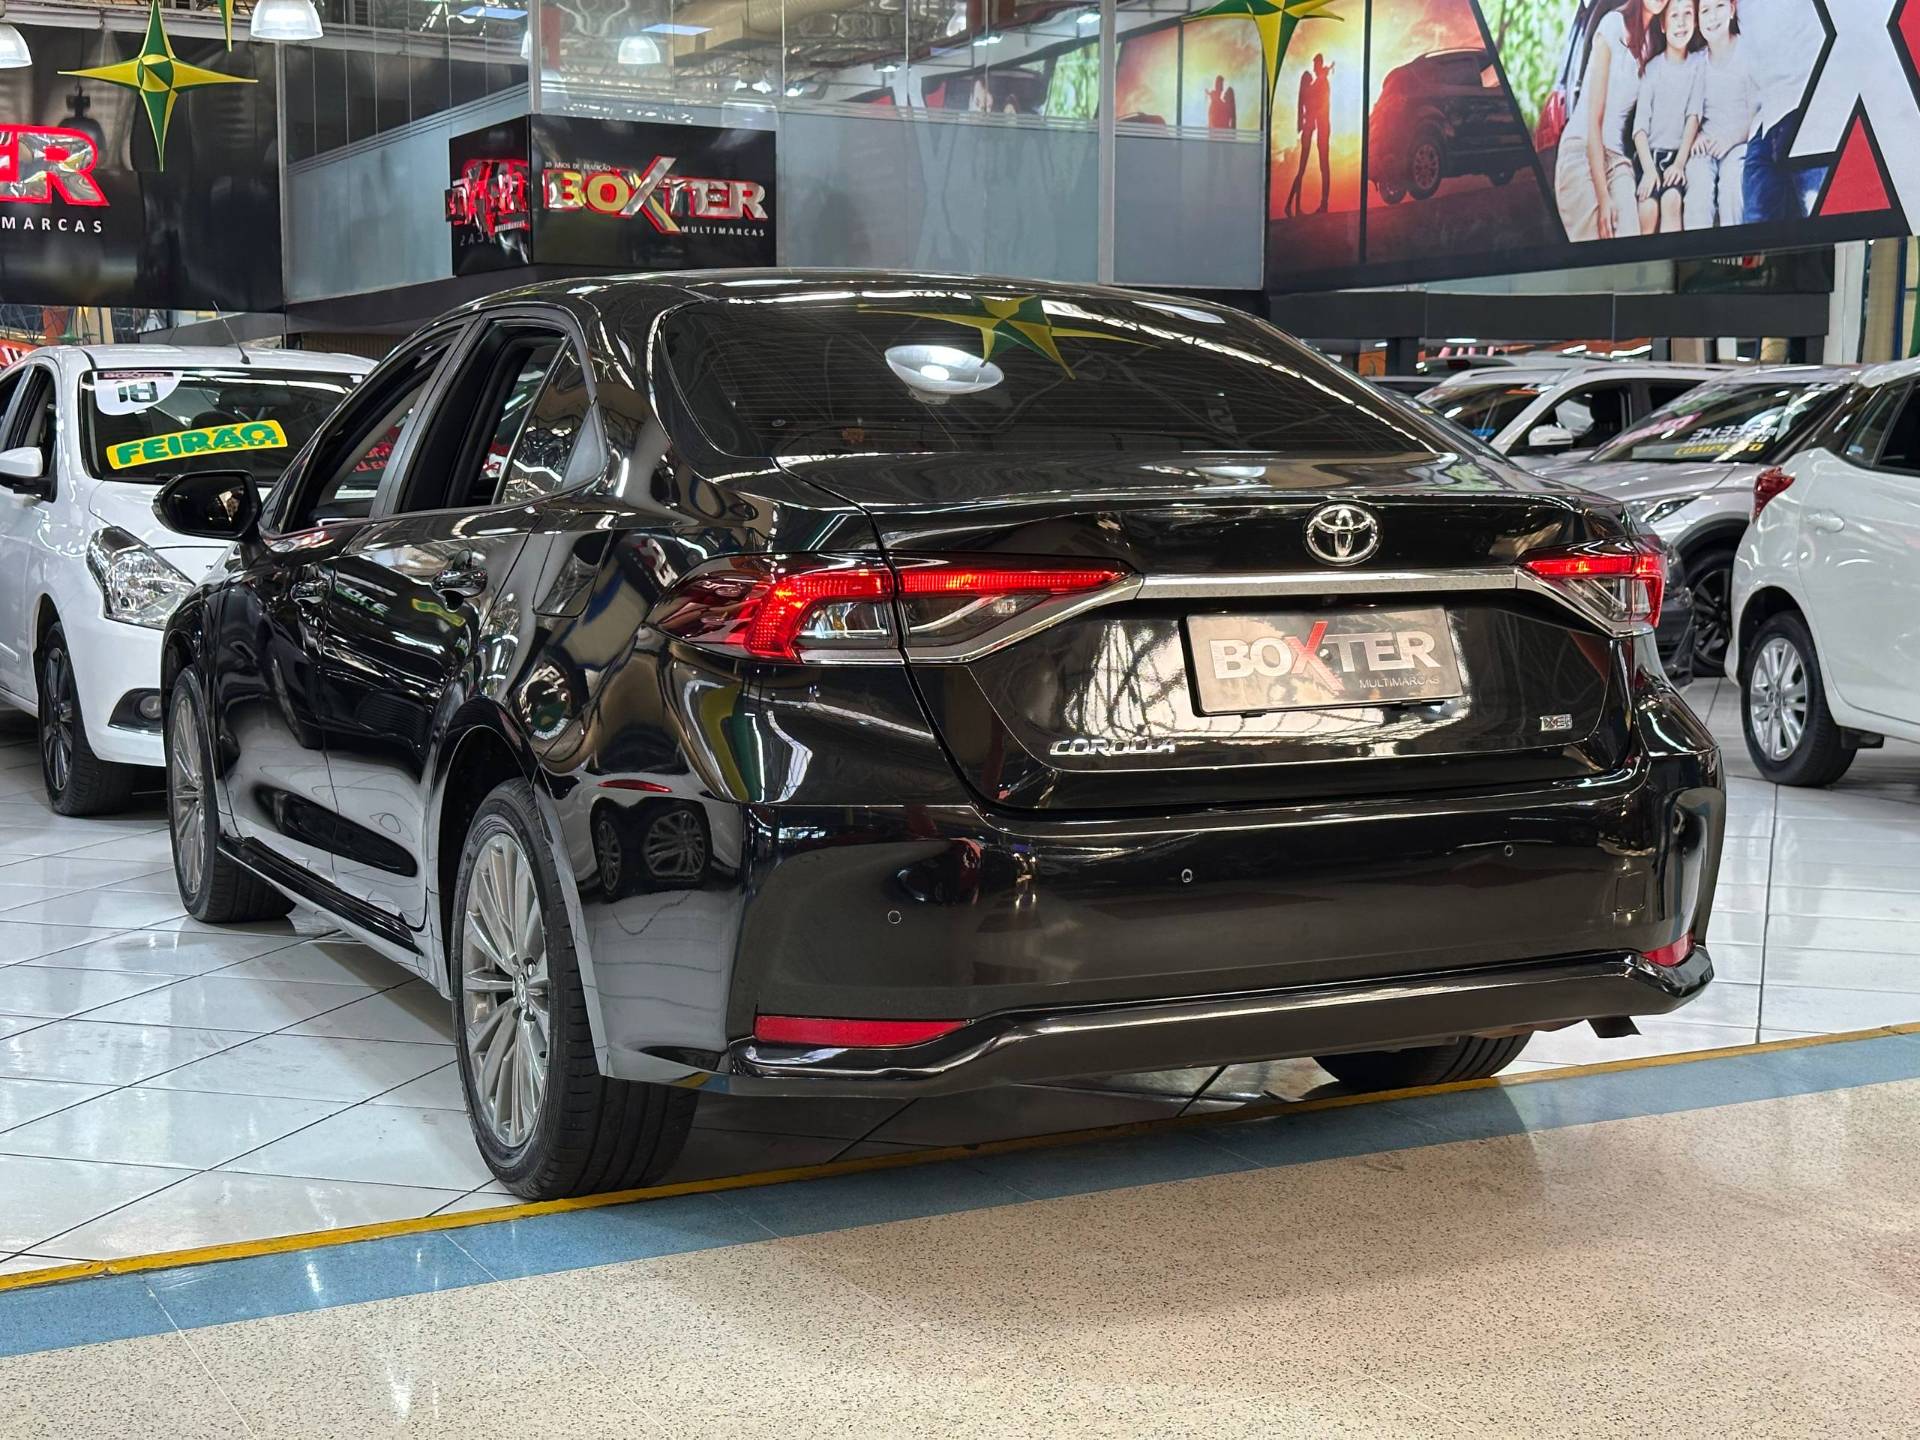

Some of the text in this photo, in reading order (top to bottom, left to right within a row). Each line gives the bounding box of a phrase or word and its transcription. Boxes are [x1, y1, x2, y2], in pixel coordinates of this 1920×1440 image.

[542, 155, 769, 234] BOXTER
[681, 225, 765, 237] MULTIMARCAS
[116, 422, 278, 465] FEIRÃO
[1209, 620, 1441, 696] BOXTER
[1359, 675, 1440, 689] MULTIMARCAS
[1050, 736, 1176, 757] COROLLA
